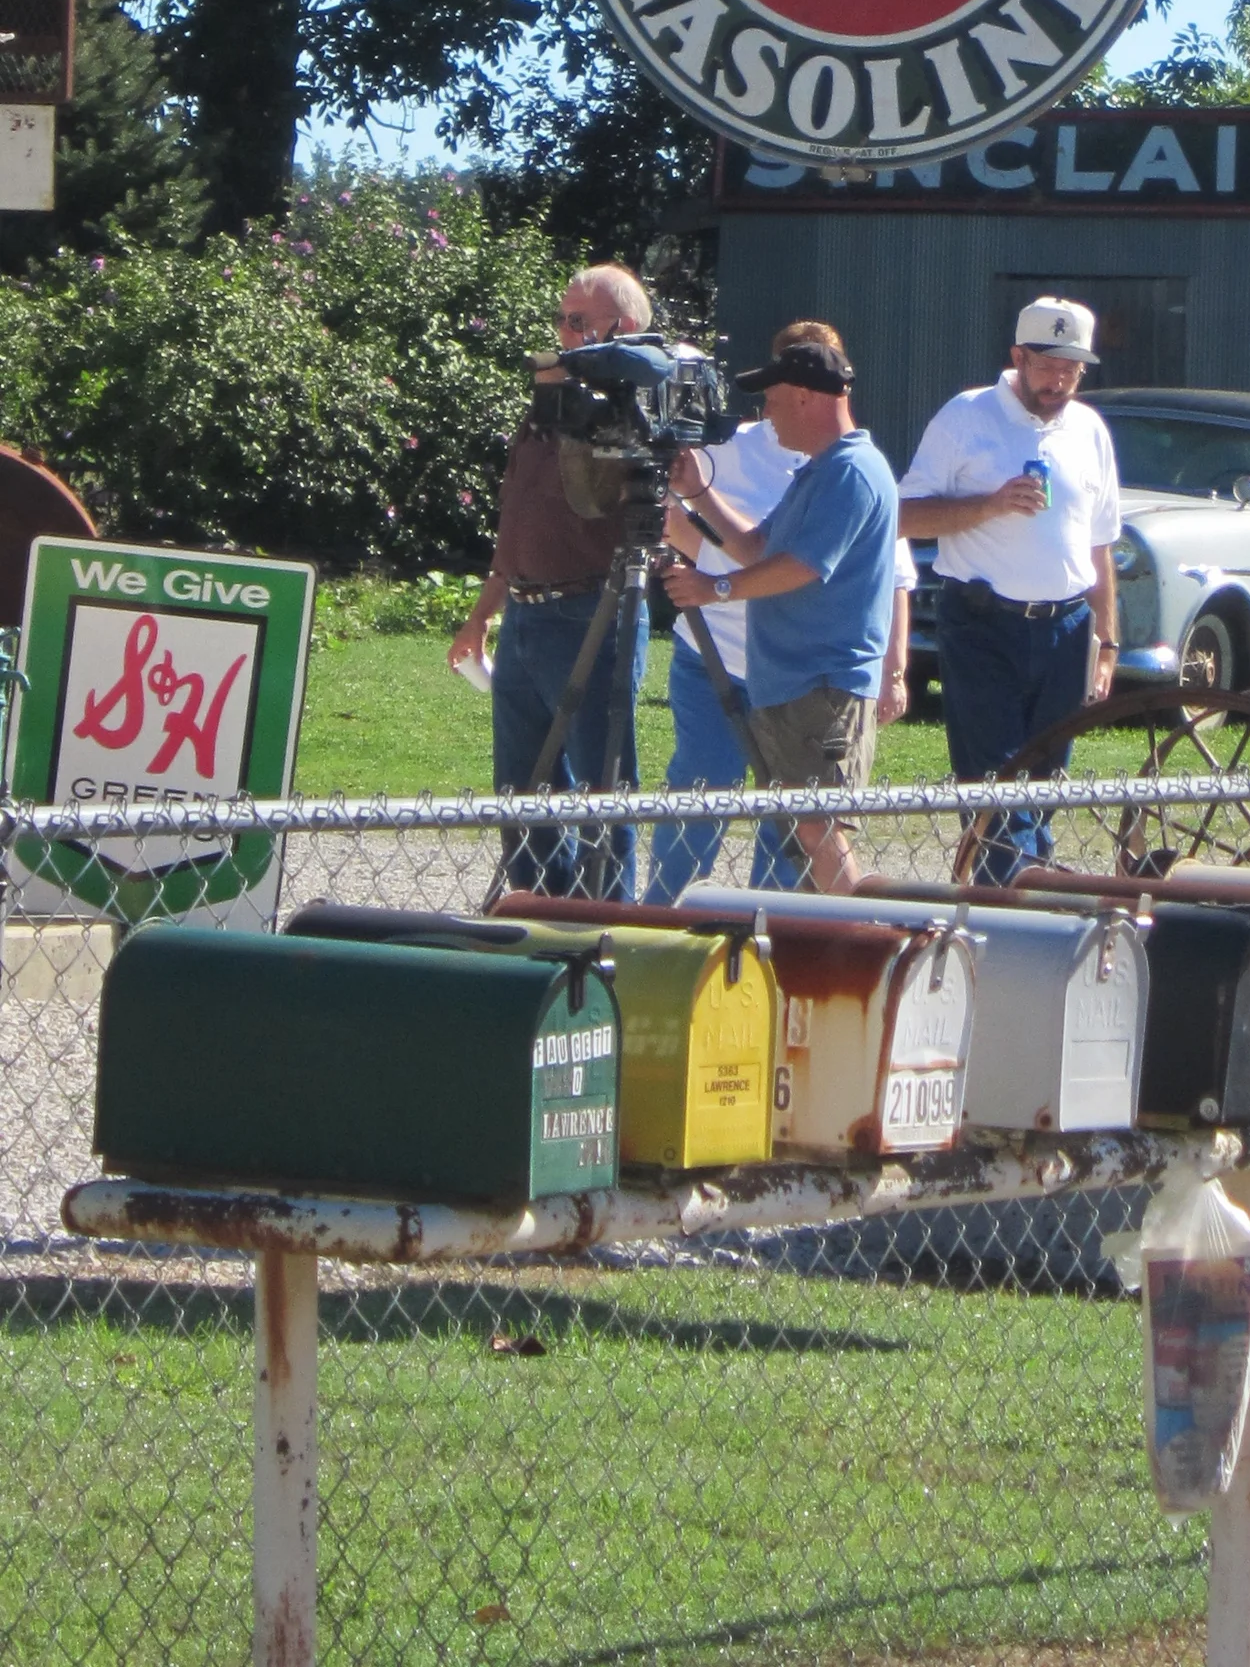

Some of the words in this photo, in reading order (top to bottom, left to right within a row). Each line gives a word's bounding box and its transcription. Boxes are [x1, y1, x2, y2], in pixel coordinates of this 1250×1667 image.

[70, 557, 147, 596] We
[163, 569, 271, 609] Give
[73, 614, 248, 779] S&H
[704, 1079, 750, 1094] LAWRENCE
[774, 1066, 791, 1111] 6
[889, 1078, 955, 1125] 21099
[543, 1107, 613, 1139] LAWRENCE
